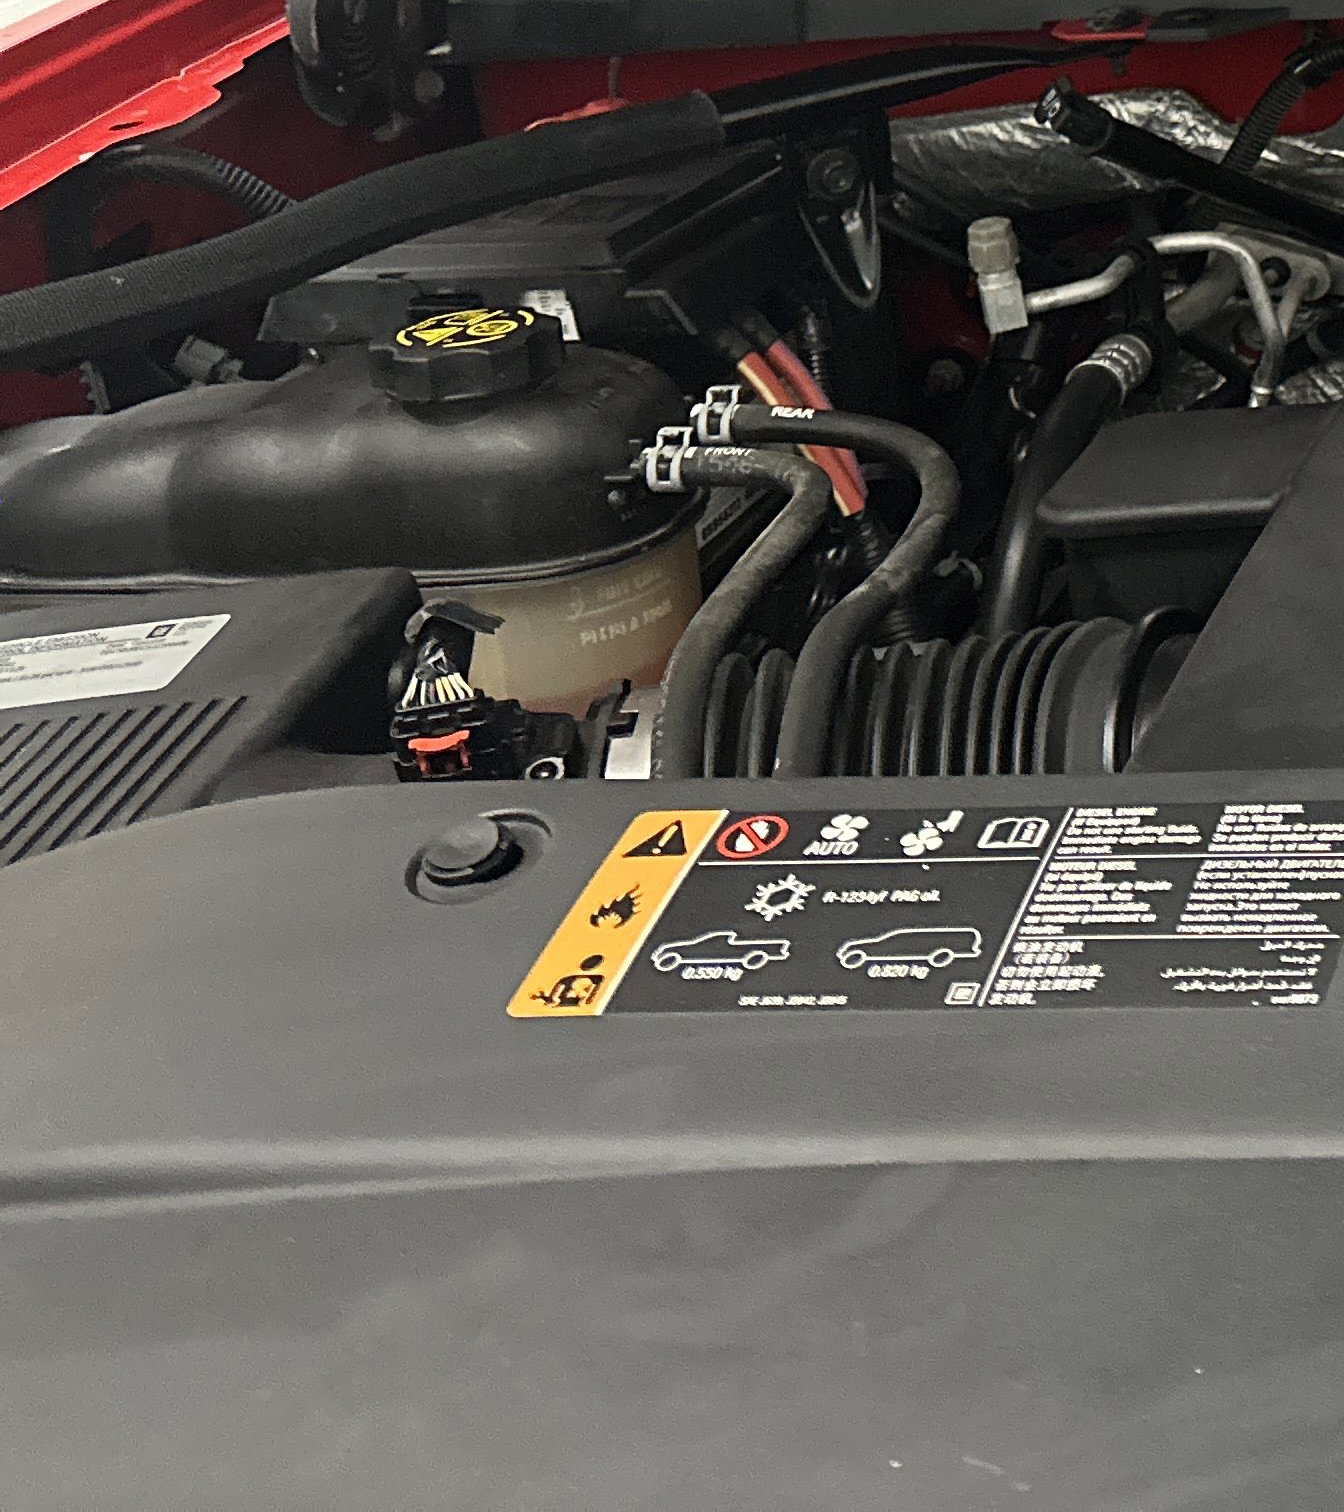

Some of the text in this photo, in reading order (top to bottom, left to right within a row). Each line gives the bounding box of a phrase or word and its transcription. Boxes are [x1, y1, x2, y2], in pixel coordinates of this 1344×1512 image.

[770, 406, 816, 419] REAR
[704, 446, 754, 457] FRONT
[803, 840, 859, 856] AUTO
[1201, 859, 1279, 870] ДИЗЕЛЬНЫЙ
[682, 966, 724, 980] 0.550
